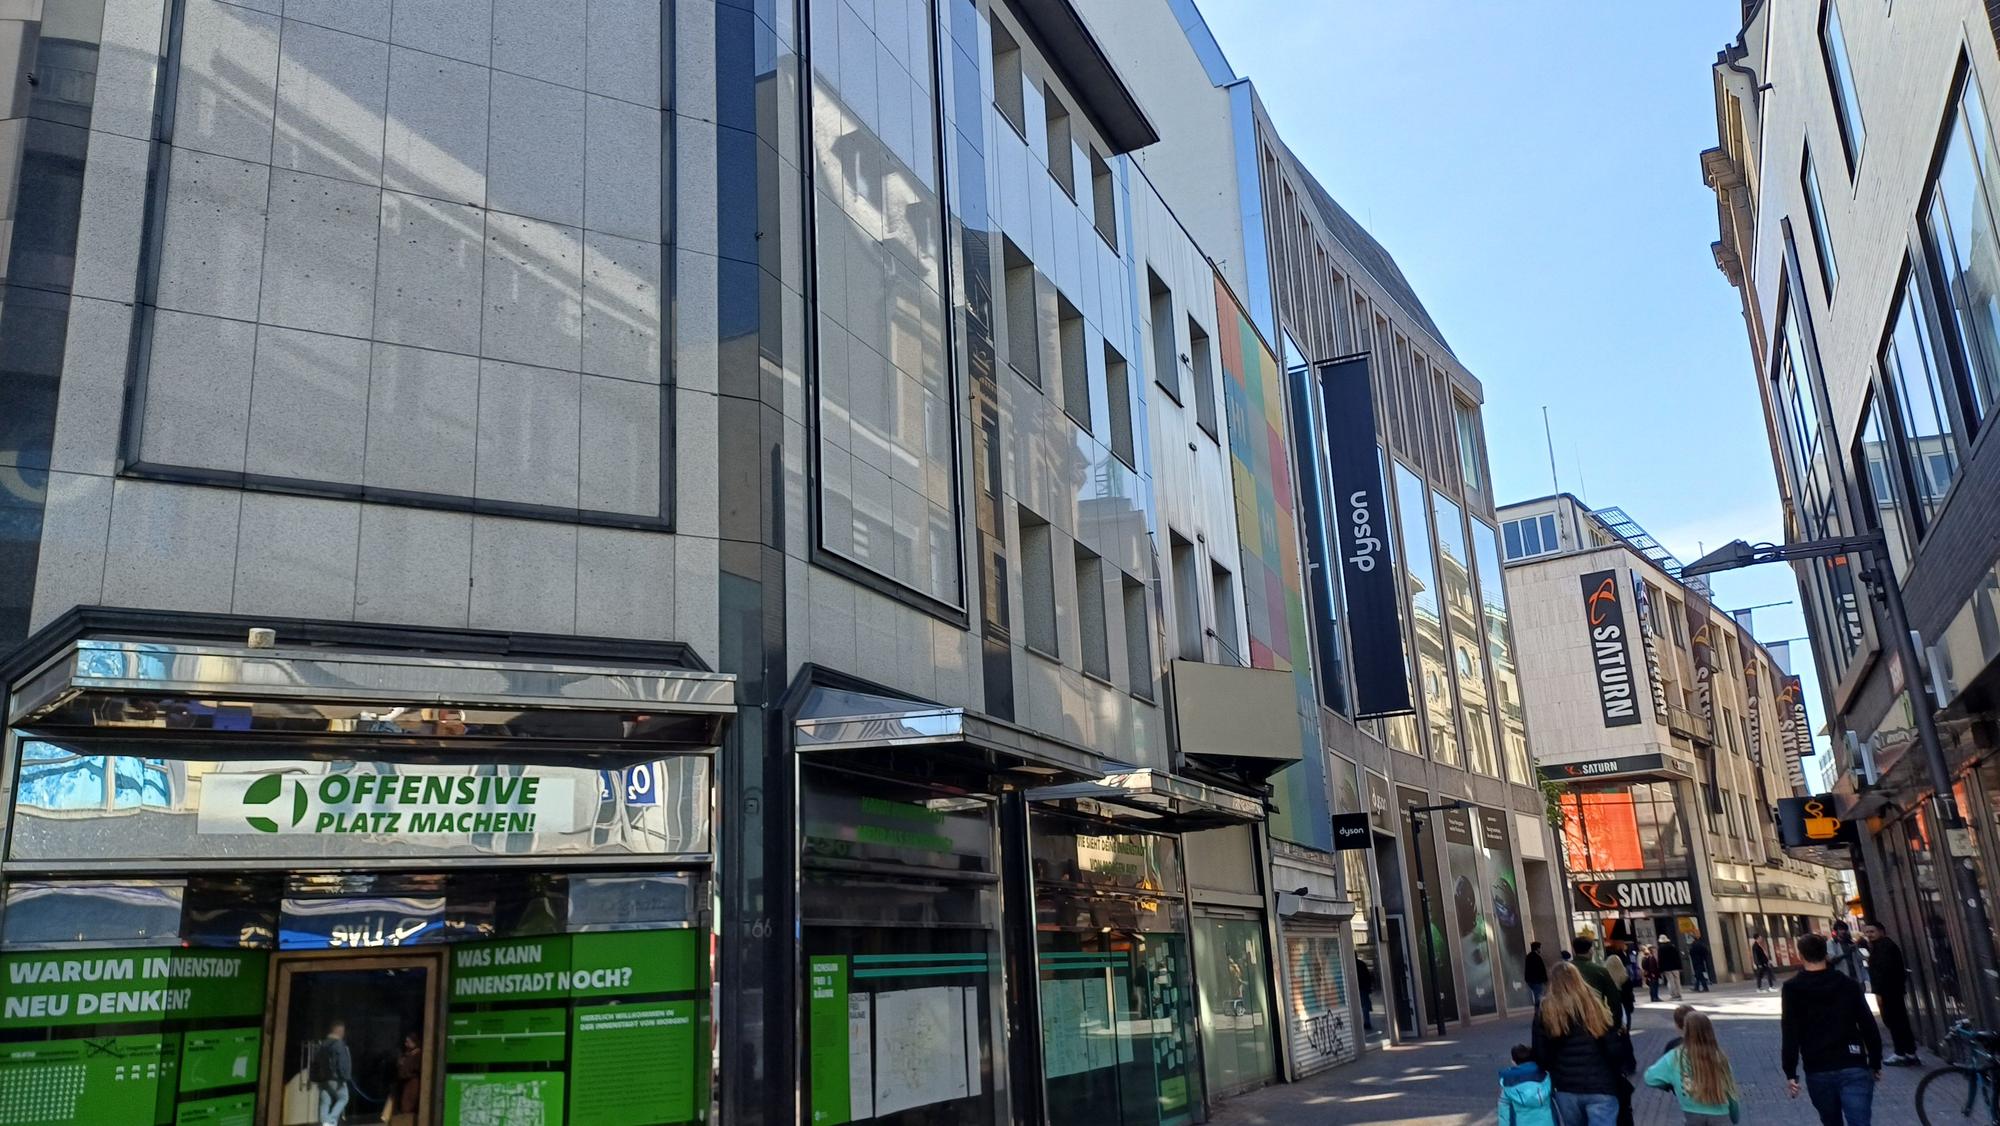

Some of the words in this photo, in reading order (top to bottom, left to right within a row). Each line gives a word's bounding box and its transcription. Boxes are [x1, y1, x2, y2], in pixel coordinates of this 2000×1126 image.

[1349, 490, 1381, 573] dyson
[1592, 625, 1634, 719] SATURN
[1794, 703, 1813, 753] SATURN
[1582, 761, 1618, 775] SATURN
[318, 774, 540, 805] OFFENSIVE
[315, 812, 400, 834] PLATZ
[407, 812, 536, 833] MACHEN!
[1339, 825, 1364, 838] dyson
[1617, 880, 1692, 908] SATURN
[751, 917, 773, 938] 66
[10, 958, 134, 984] WARUM
[142, 957, 241, 980] INNENSTADT
[457, 948, 491, 968] WAS
[495, 945, 542, 965] KANN
[456, 971, 555, 996] INNENSTADT
[557, 967, 632, 991] NOCH?
[4, 994, 69, 1018] NEU
[76, 988, 191, 1015] DENKEN?
